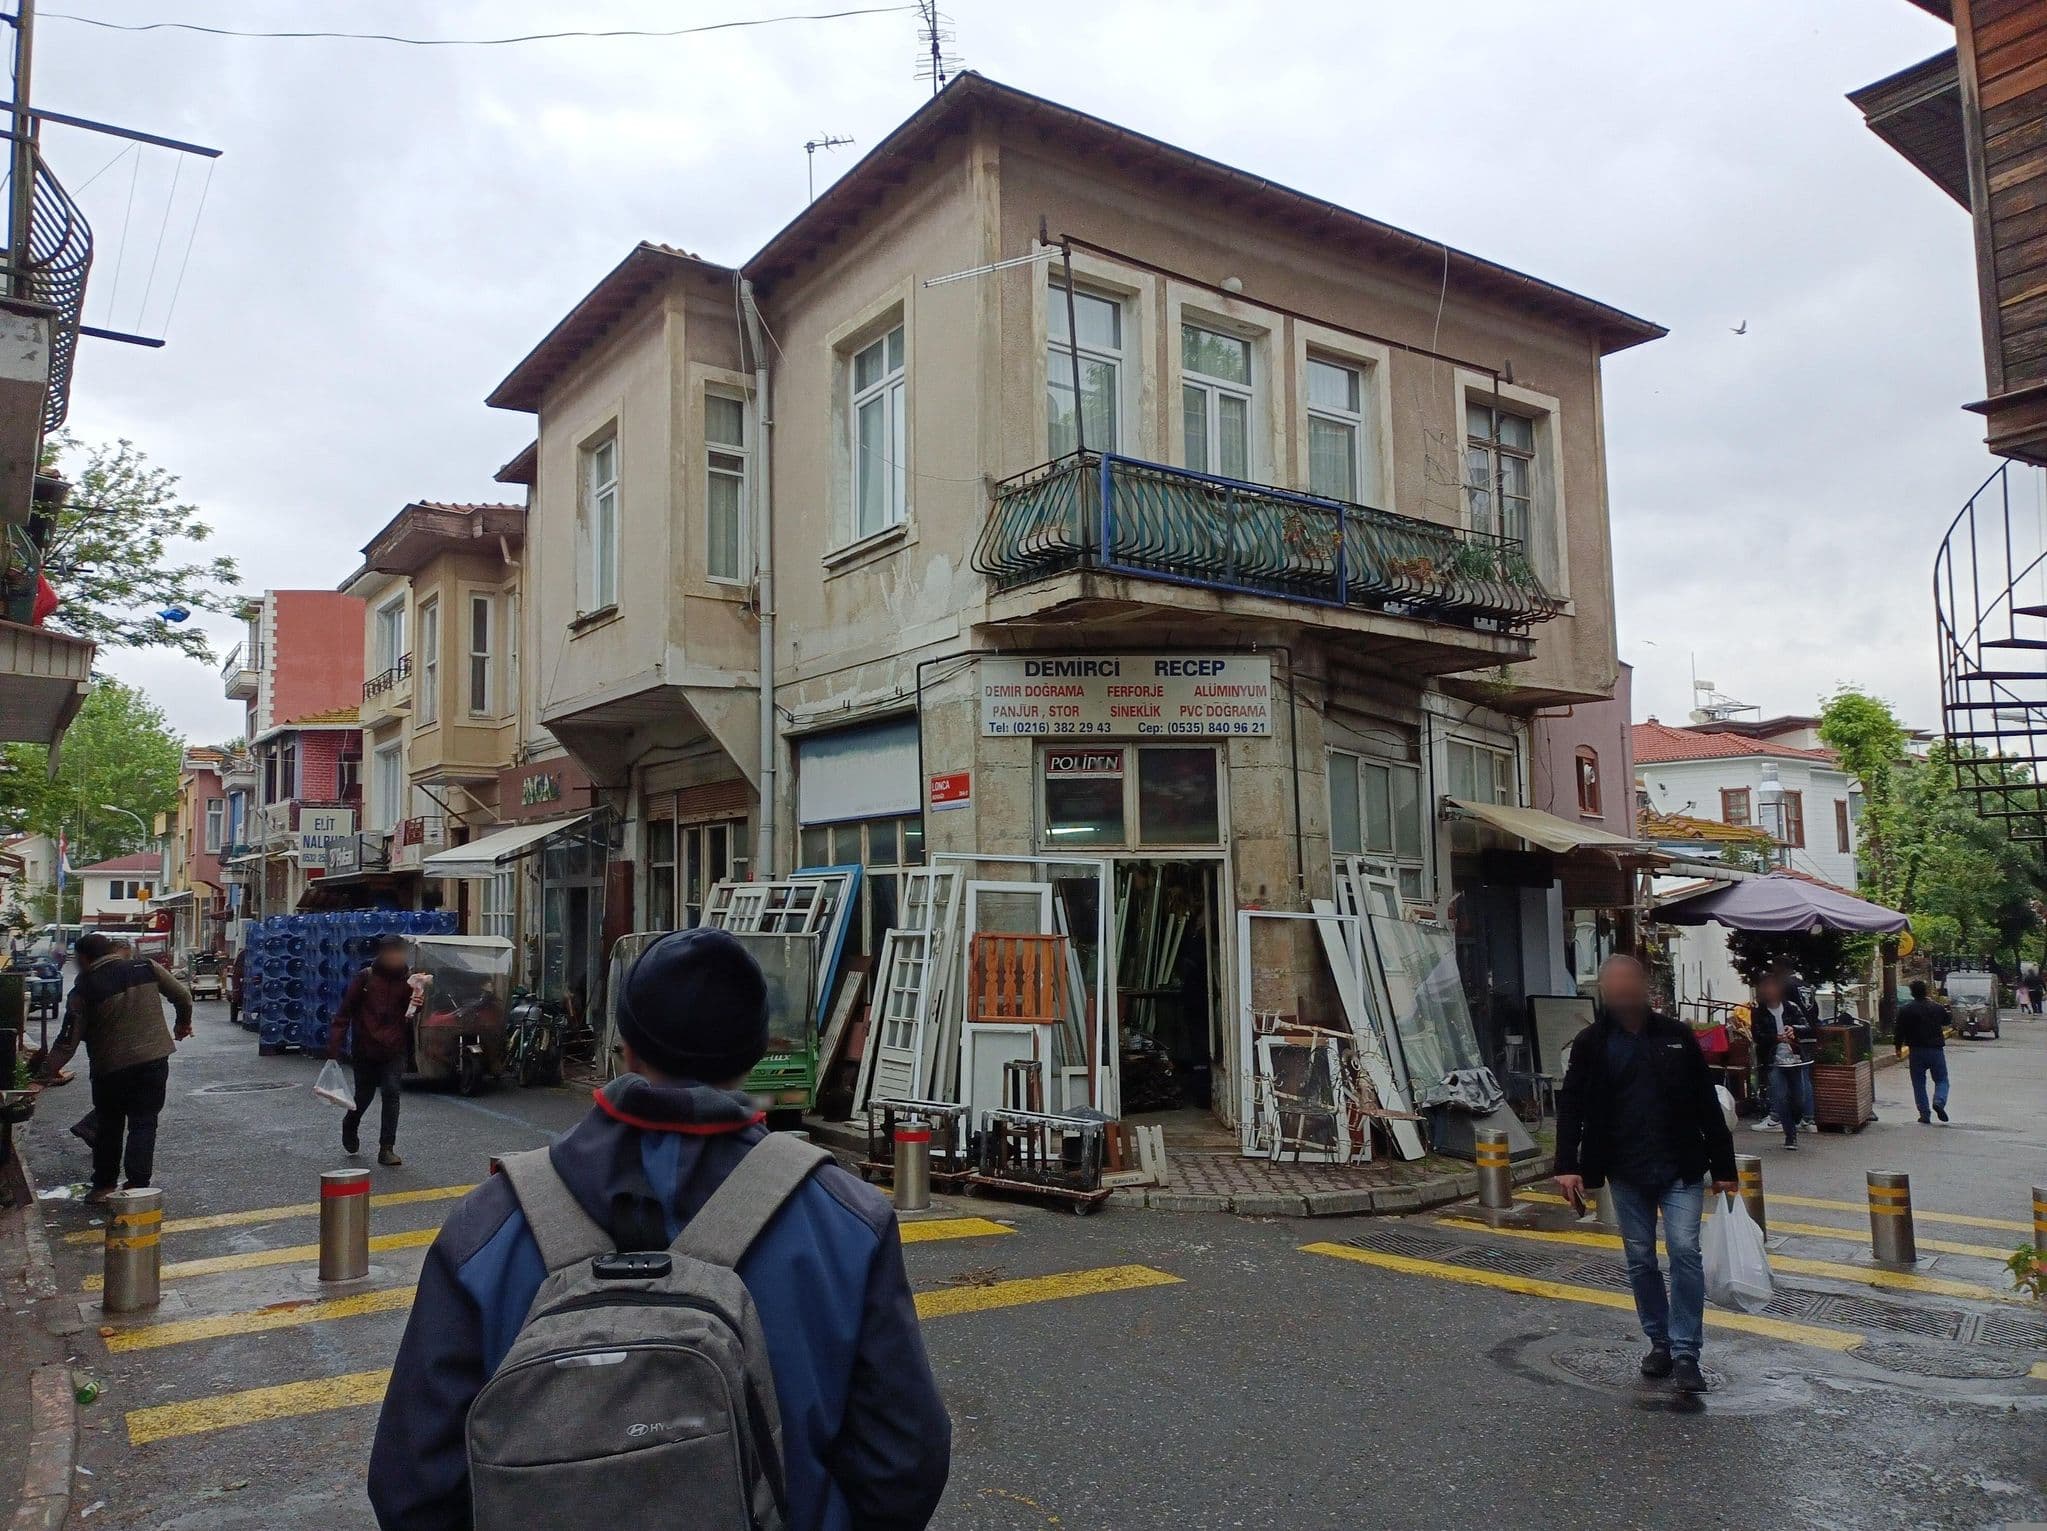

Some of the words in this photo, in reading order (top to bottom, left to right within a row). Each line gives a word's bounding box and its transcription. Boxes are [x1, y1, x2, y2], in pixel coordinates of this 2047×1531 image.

[1024, 657, 1120, 677] DEMİRCİ
[1154, 660, 1225, 677] RECEP
[1025, 683, 1085, 697] DOĞRAMA
[1107, 684, 1164, 697] FERFORJE
[1048, 705, 1080, 718] STOR
[1110, 703, 1161, 718] SİNEKLİK
[1179, 705, 1203, 717] PVC
[989, 722, 1009, 733] Tel:
[1013, 722, 1050, 734] (0216)
[1054, 722, 1075, 733] 382
[1079, 722, 1093, 733] 29
[1097, 722, 1112, 733] 43
[1138, 722, 1164, 735] Cep:
[1167, 722, 1205, 735] (0535)
[1208, 722, 1230, 733] 840
[1233, 722, 1248, 733] 96
[1252, 723, 1265, 733] 21
[314, 815, 336, 831] ELİT
